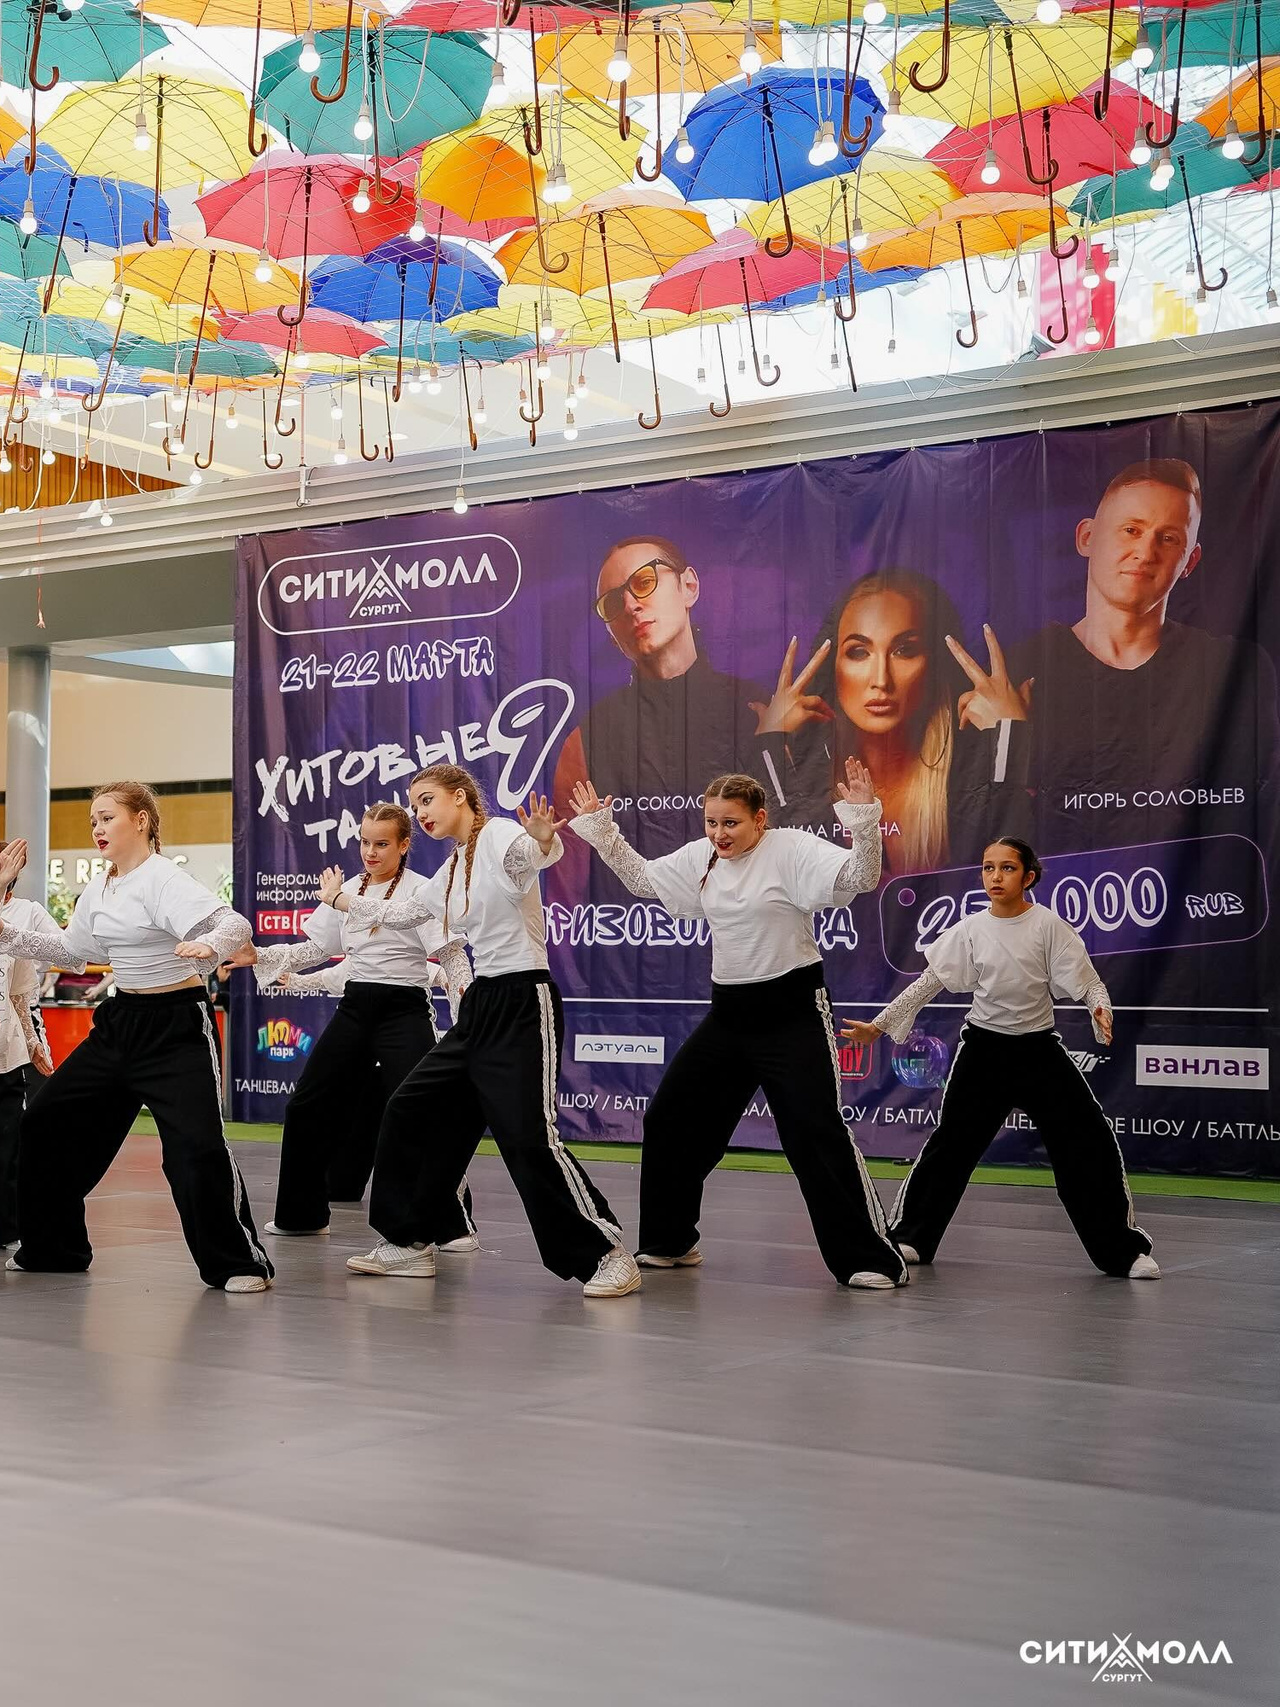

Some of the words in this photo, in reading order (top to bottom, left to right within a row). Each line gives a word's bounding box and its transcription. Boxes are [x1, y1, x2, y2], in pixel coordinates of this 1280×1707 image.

[359, 603, 401, 617] СУРГУТ
[279, 650, 380, 693] 21-22
[387, 636, 495, 684] МАРТА
[255, 721, 494, 822] ХИТОВЫЕ
[637, 795, 706, 811] СОКОЛО
[1064, 791, 1127, 809] ИГОРЬ
[1133, 787, 1245, 808] СОЛОВЬЕВ
[1185, 893, 1245, 920] RUB
[270, 1046, 295, 1058] парк
[1145, 1056, 1261, 1077] ванлав
[559, 1093, 599, 1109] ШОУ
[840, 1105, 867, 1121] ОУ
[1132, 1117, 1185, 1136] ШОУ
